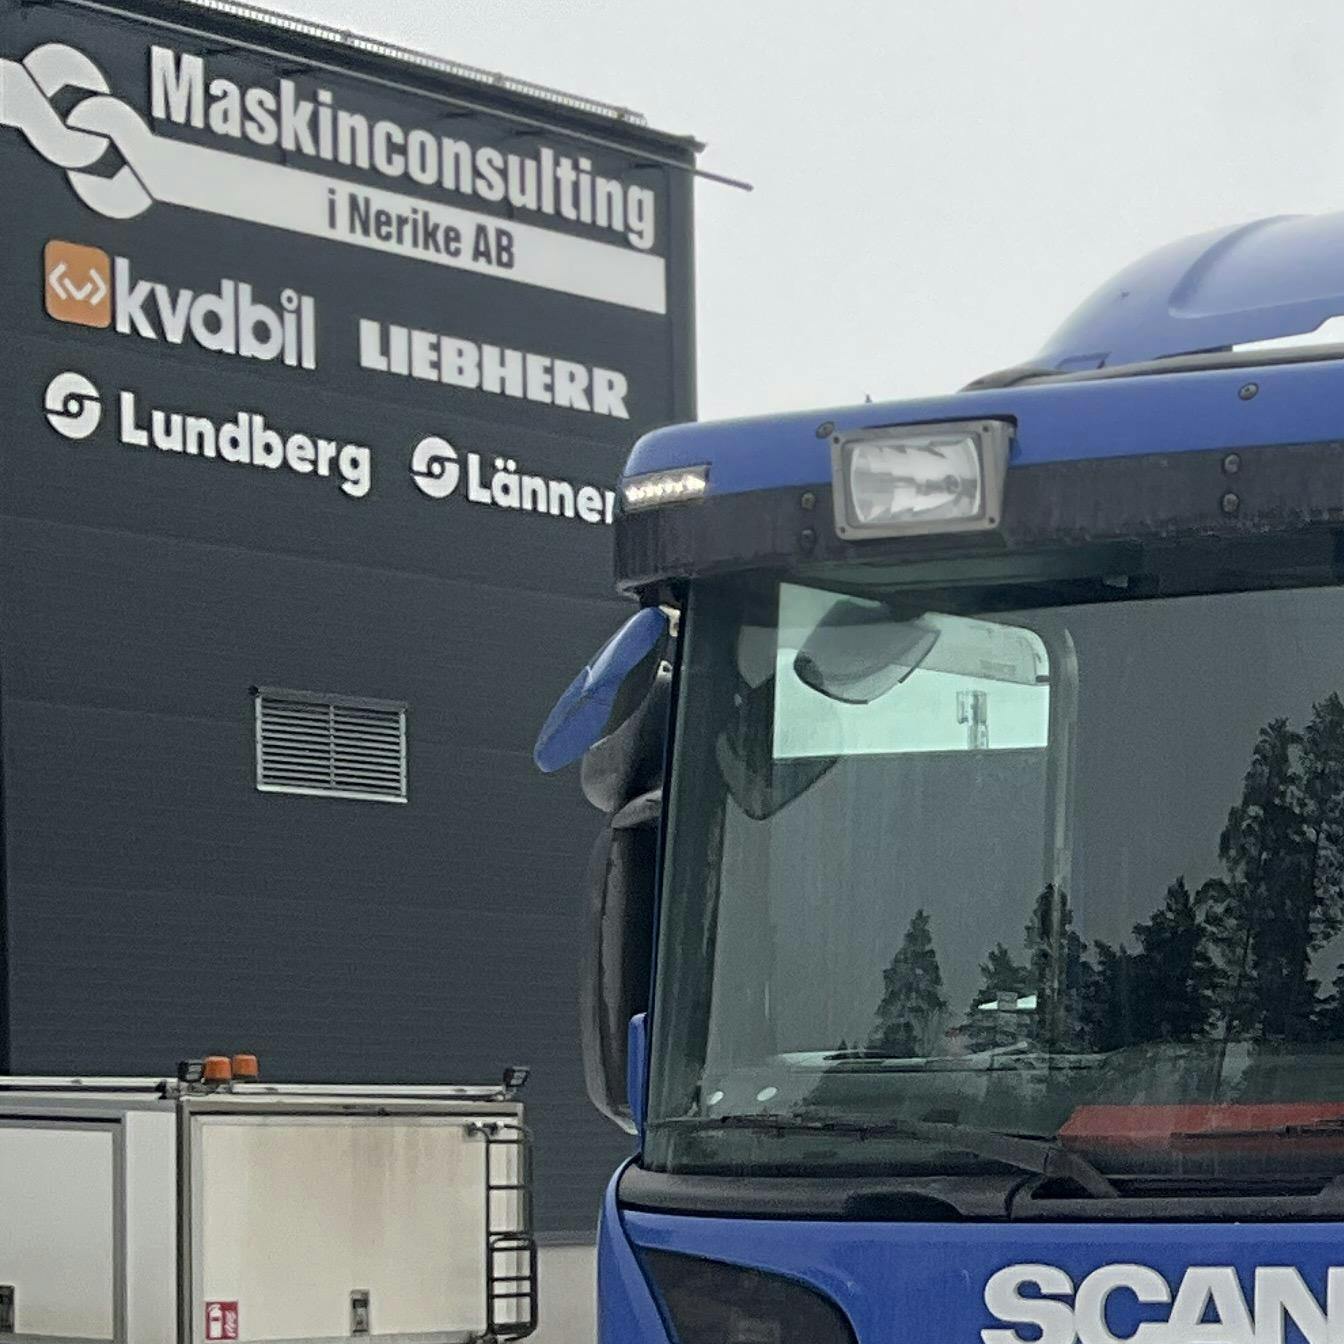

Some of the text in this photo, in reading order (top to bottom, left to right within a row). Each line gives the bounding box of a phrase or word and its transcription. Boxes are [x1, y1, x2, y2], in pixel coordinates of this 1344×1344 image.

[150, 45, 656, 250] Maskinconsulting
[327, 188, 515, 270] i Nerike AB
[114, 256, 316, 370] kvdbil
[359, 318, 630, 420] LIEBHERR
[120, 391, 371, 498] Lundberg
